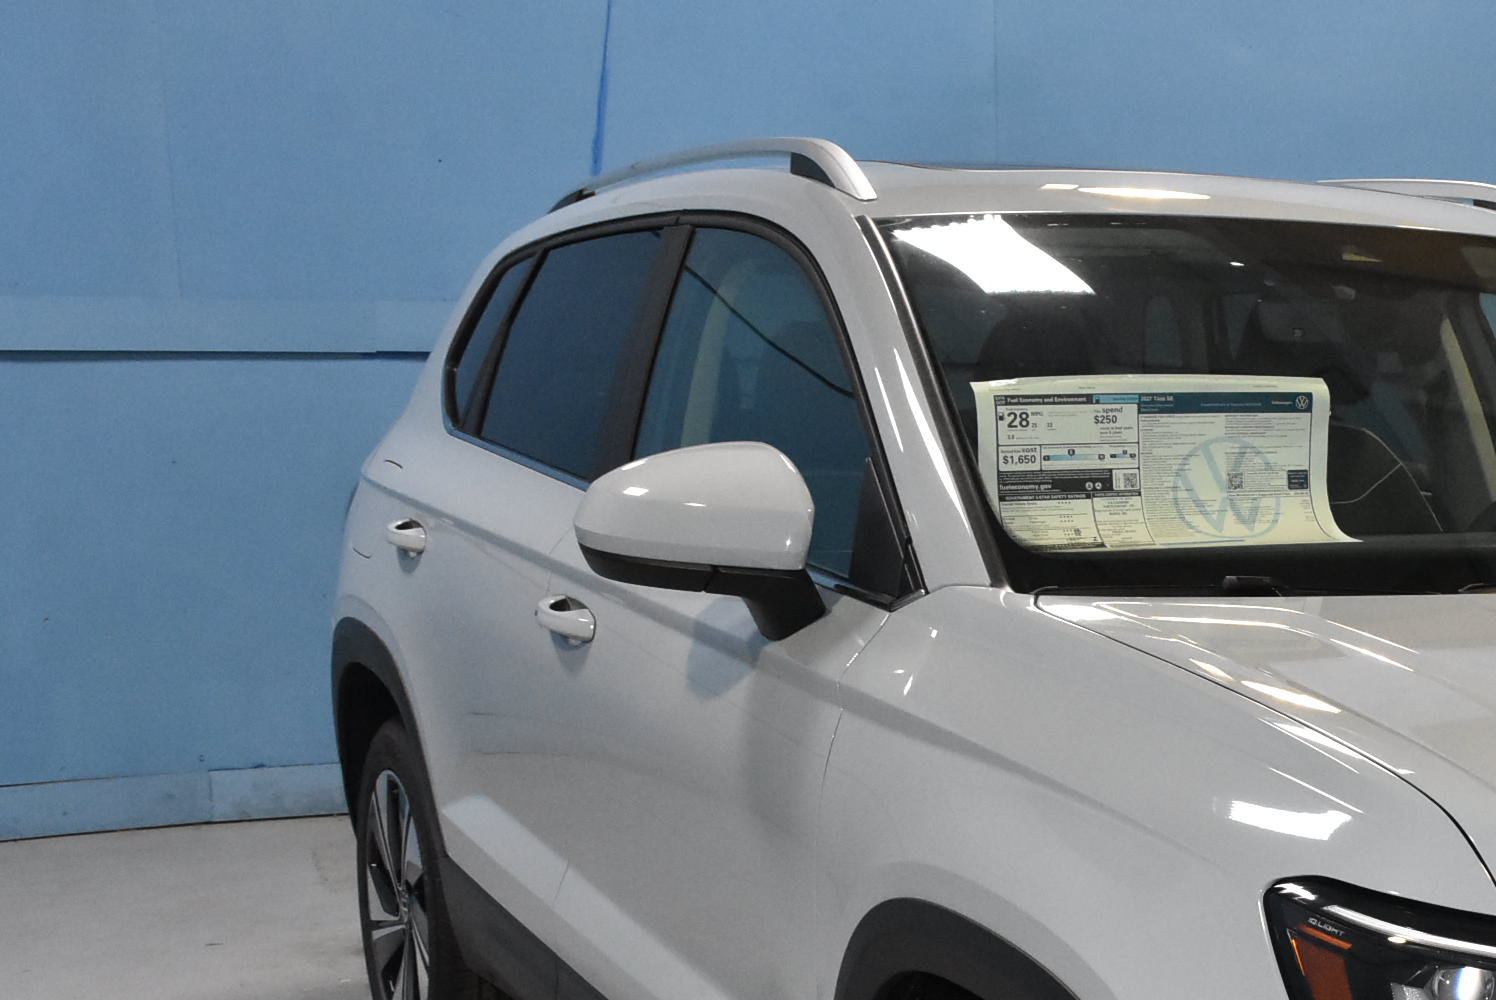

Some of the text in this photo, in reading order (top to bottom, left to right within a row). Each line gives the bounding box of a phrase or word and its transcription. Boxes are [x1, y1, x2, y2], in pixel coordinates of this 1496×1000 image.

[1102, 406, 1123, 414] spend
[1007, 411, 1030, 428] 28
[1094, 414, 1117, 425] $250
[1002, 455, 1037, 465] $1,650
